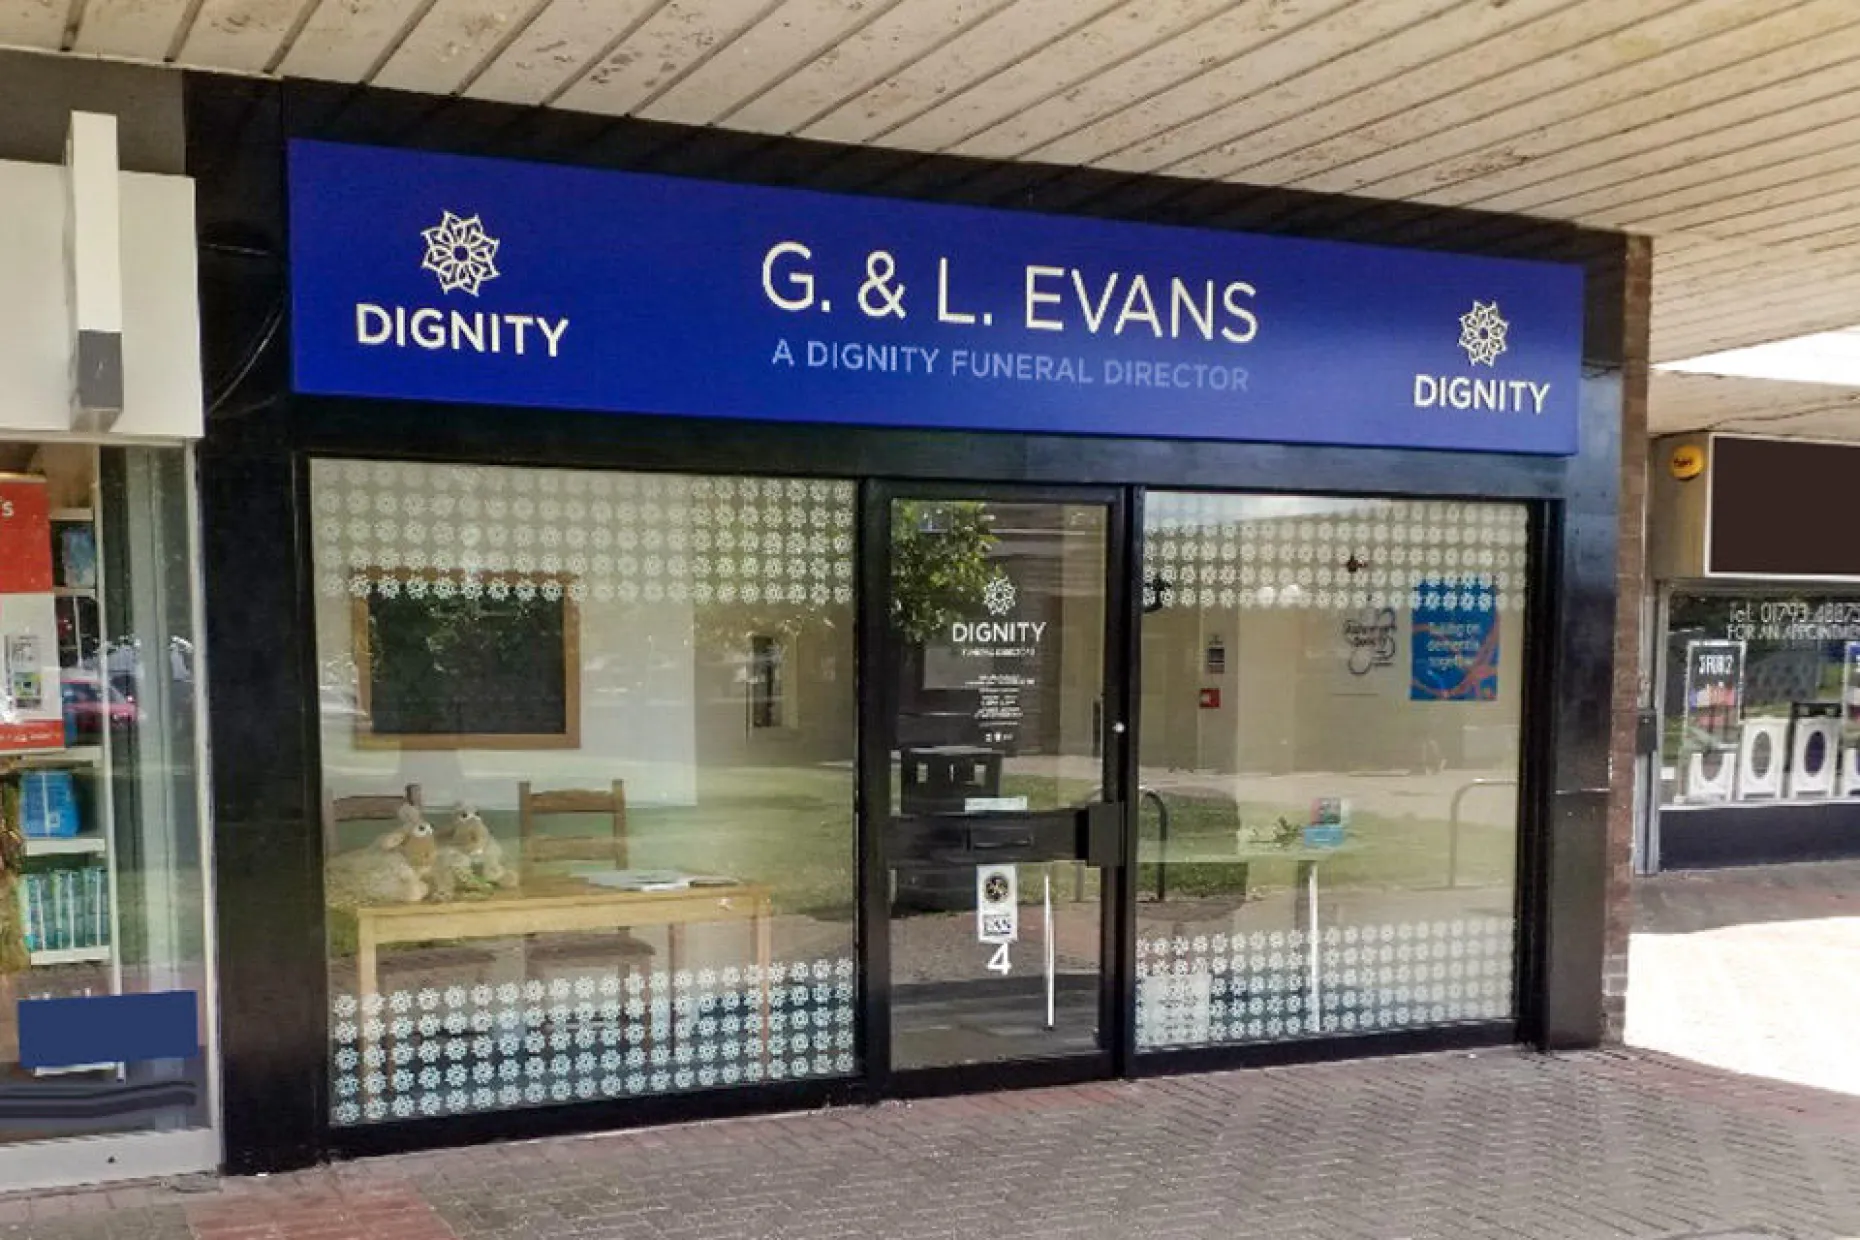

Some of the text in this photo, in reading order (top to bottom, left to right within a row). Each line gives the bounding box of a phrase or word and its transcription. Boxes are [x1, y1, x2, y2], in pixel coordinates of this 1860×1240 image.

[763, 241, 1259, 344] G. & L. EVANS
[355, 303, 569, 357] DIGNITY
[771, 339, 1250, 393] A DIGNITY FUNERAL DIRECTOR
[1413, 373, 1551, 415] DIGNITY
[952, 621, 1047, 643] DIGNITY
[986, 941, 1012, 976] 4
